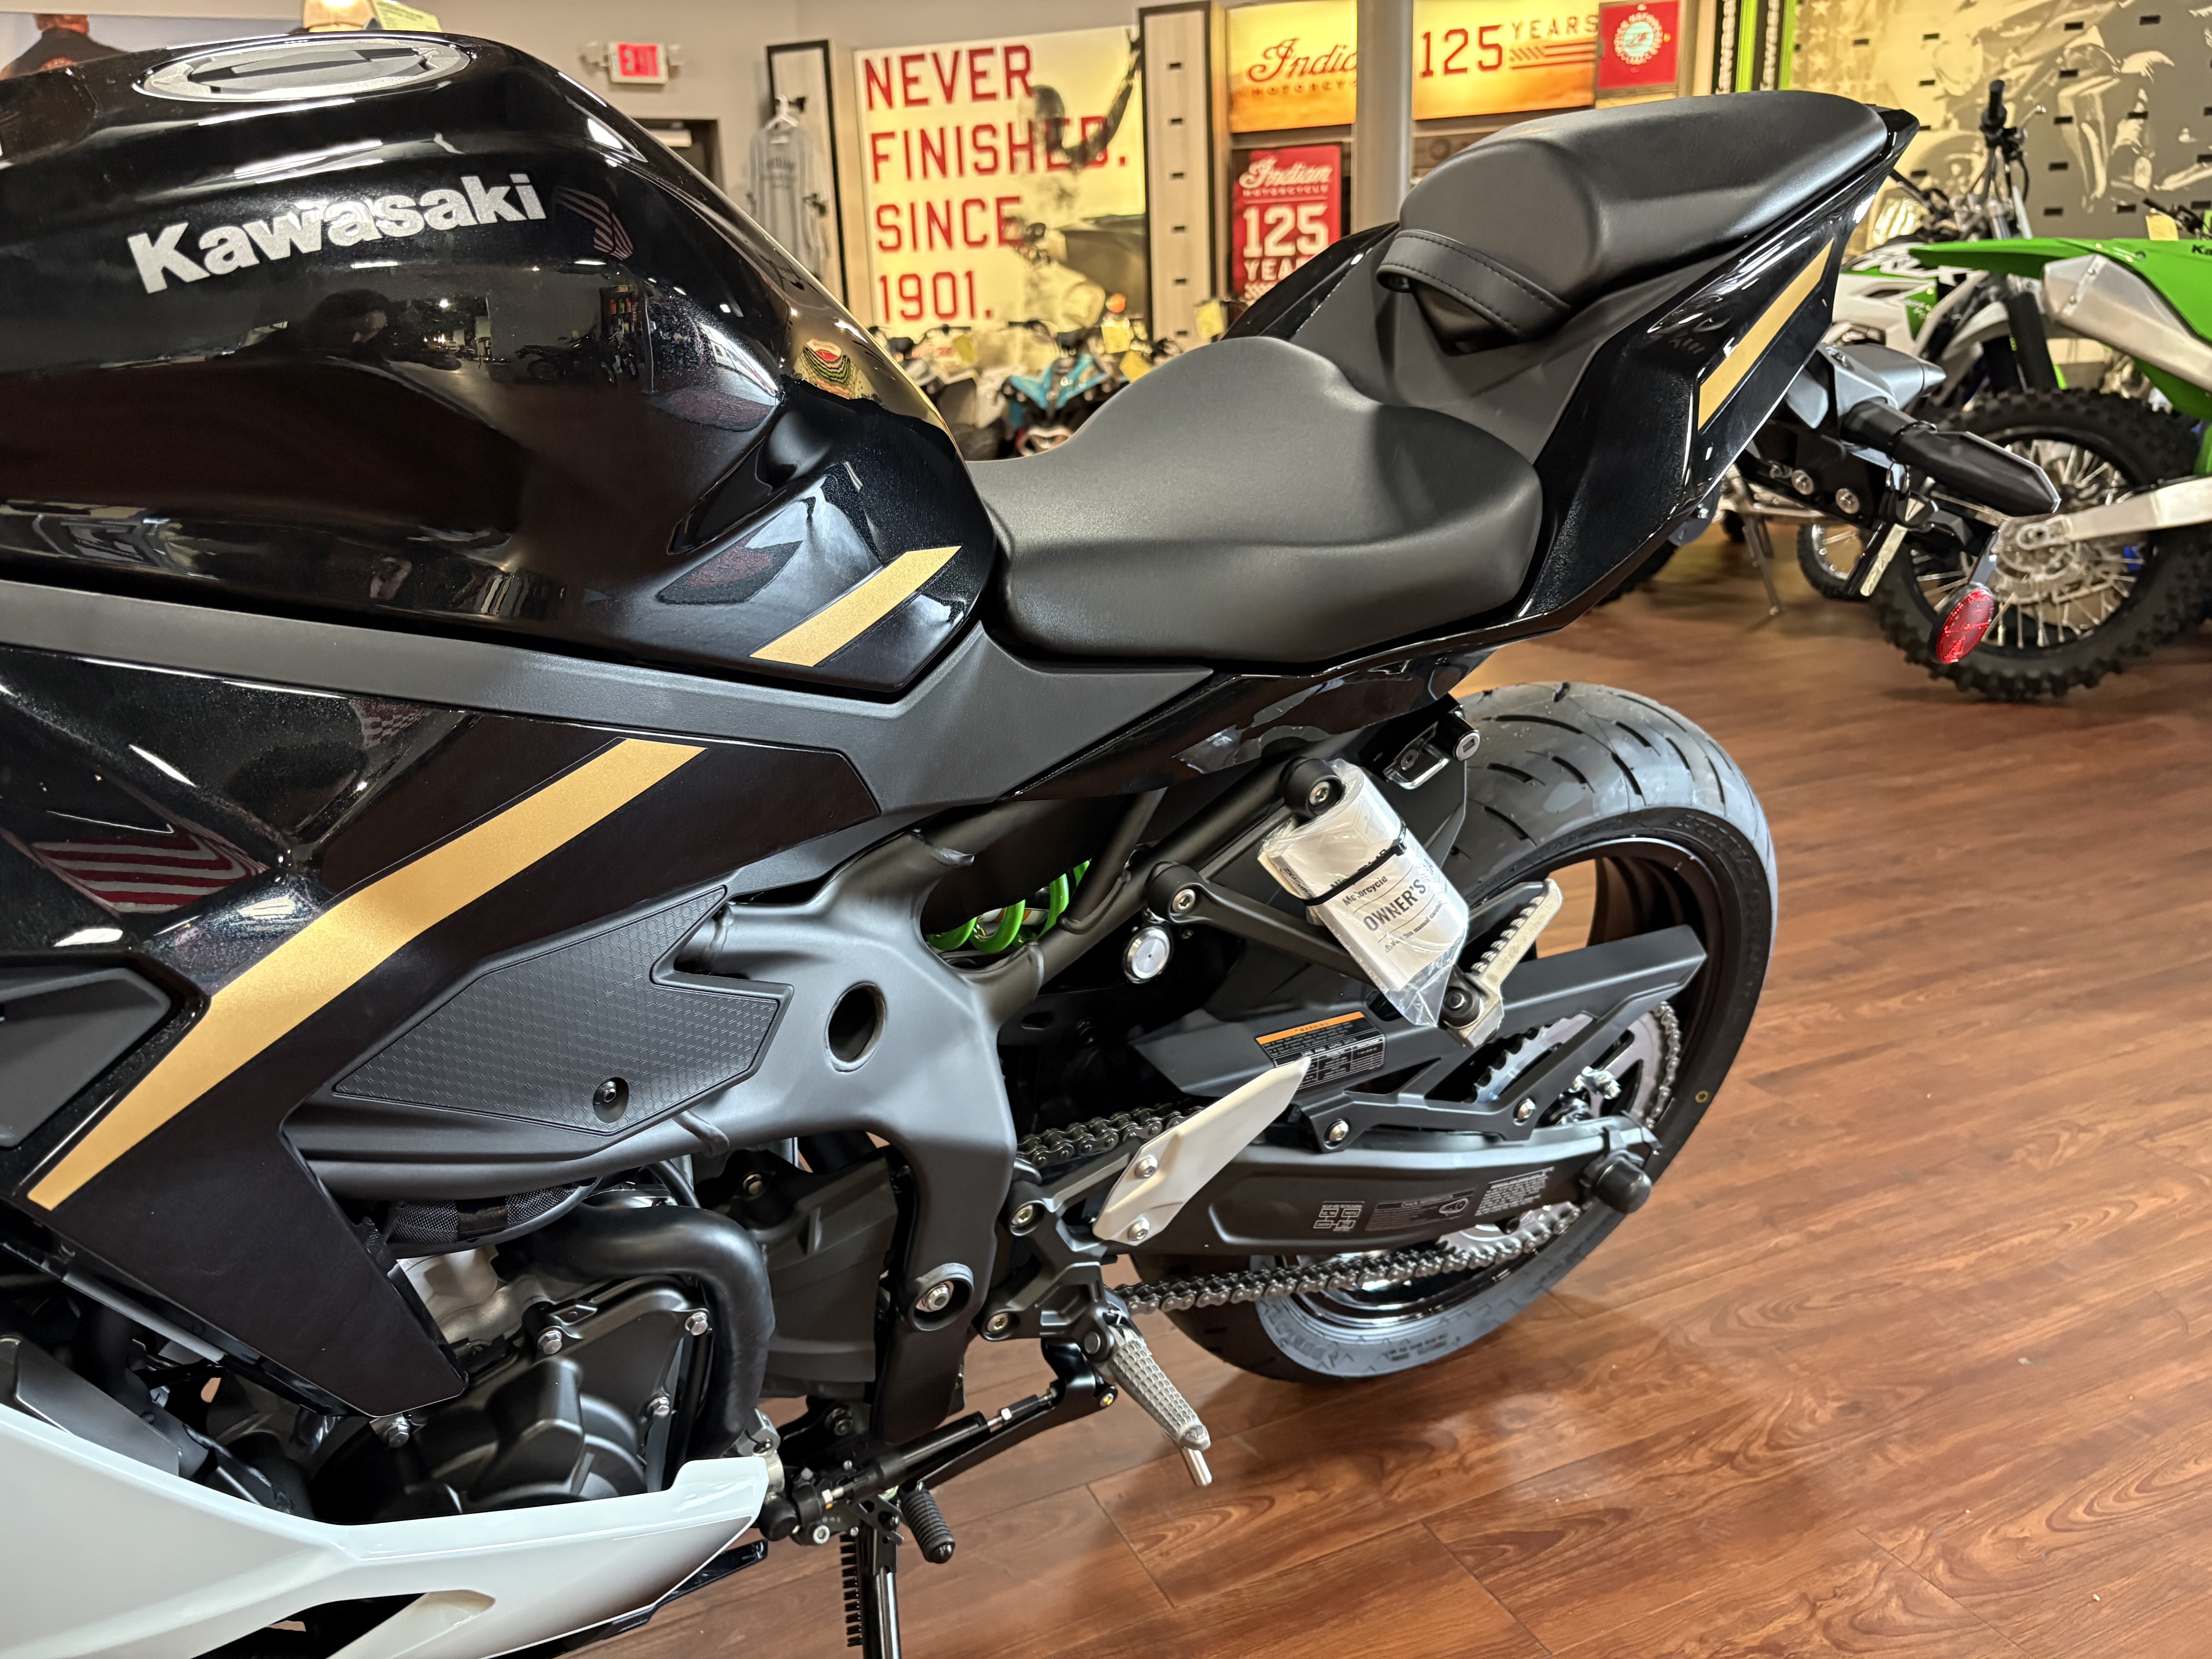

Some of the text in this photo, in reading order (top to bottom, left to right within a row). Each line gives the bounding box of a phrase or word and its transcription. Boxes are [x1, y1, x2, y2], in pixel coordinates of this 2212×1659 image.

[1420, 24, 1503, 78] 125
[1511, 15, 1599, 39] YEARS
[864, 45, 1033, 111] NEVER
[1239, 156, 1333, 189] Indian
[127, 173, 547, 294] Kawasaki
[876, 196, 1024, 252] SINCE
[1243, 202, 1329, 258] 125
[879, 270, 994, 323] 1901.
[1362, 878, 1427, 932] OWNER'S
